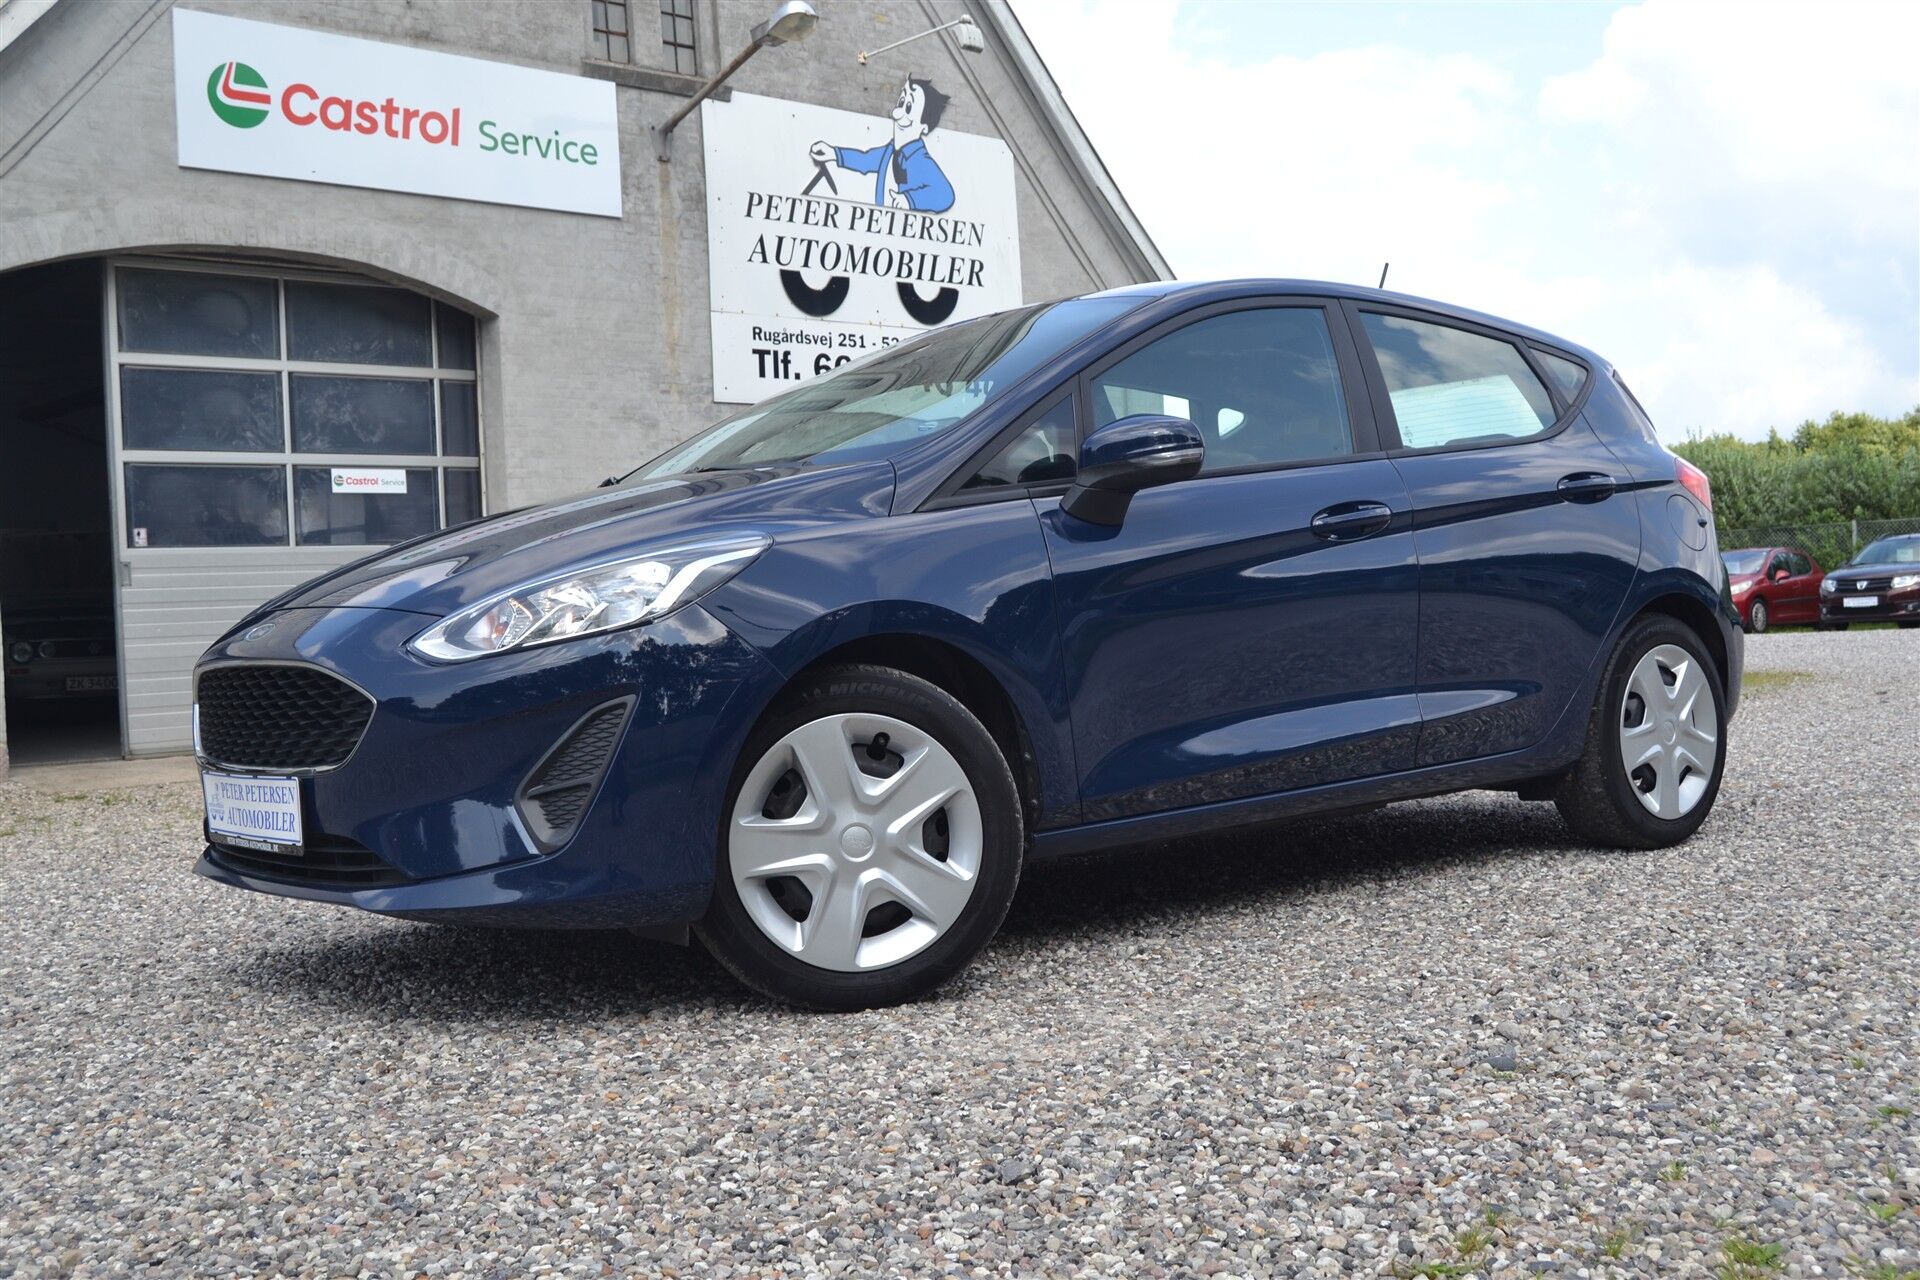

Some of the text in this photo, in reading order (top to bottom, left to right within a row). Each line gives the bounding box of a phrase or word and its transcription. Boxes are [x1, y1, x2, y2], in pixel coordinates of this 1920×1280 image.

[281, 82, 599, 166] Castrol Service
[744, 191, 985, 248] PETER PETERSEN
[747, 232, 985, 288] AUTOMOBILER
[752, 326, 833, 348] Rugårdsvej
[838, 333, 866, 348] 251
[752, 348, 801, 380] Tlf.
[346, 477, 378, 485] Castrol
[221, 782, 295, 804] PETER PETERSEN
[228, 807, 295, 832] AUTOMOBILER
